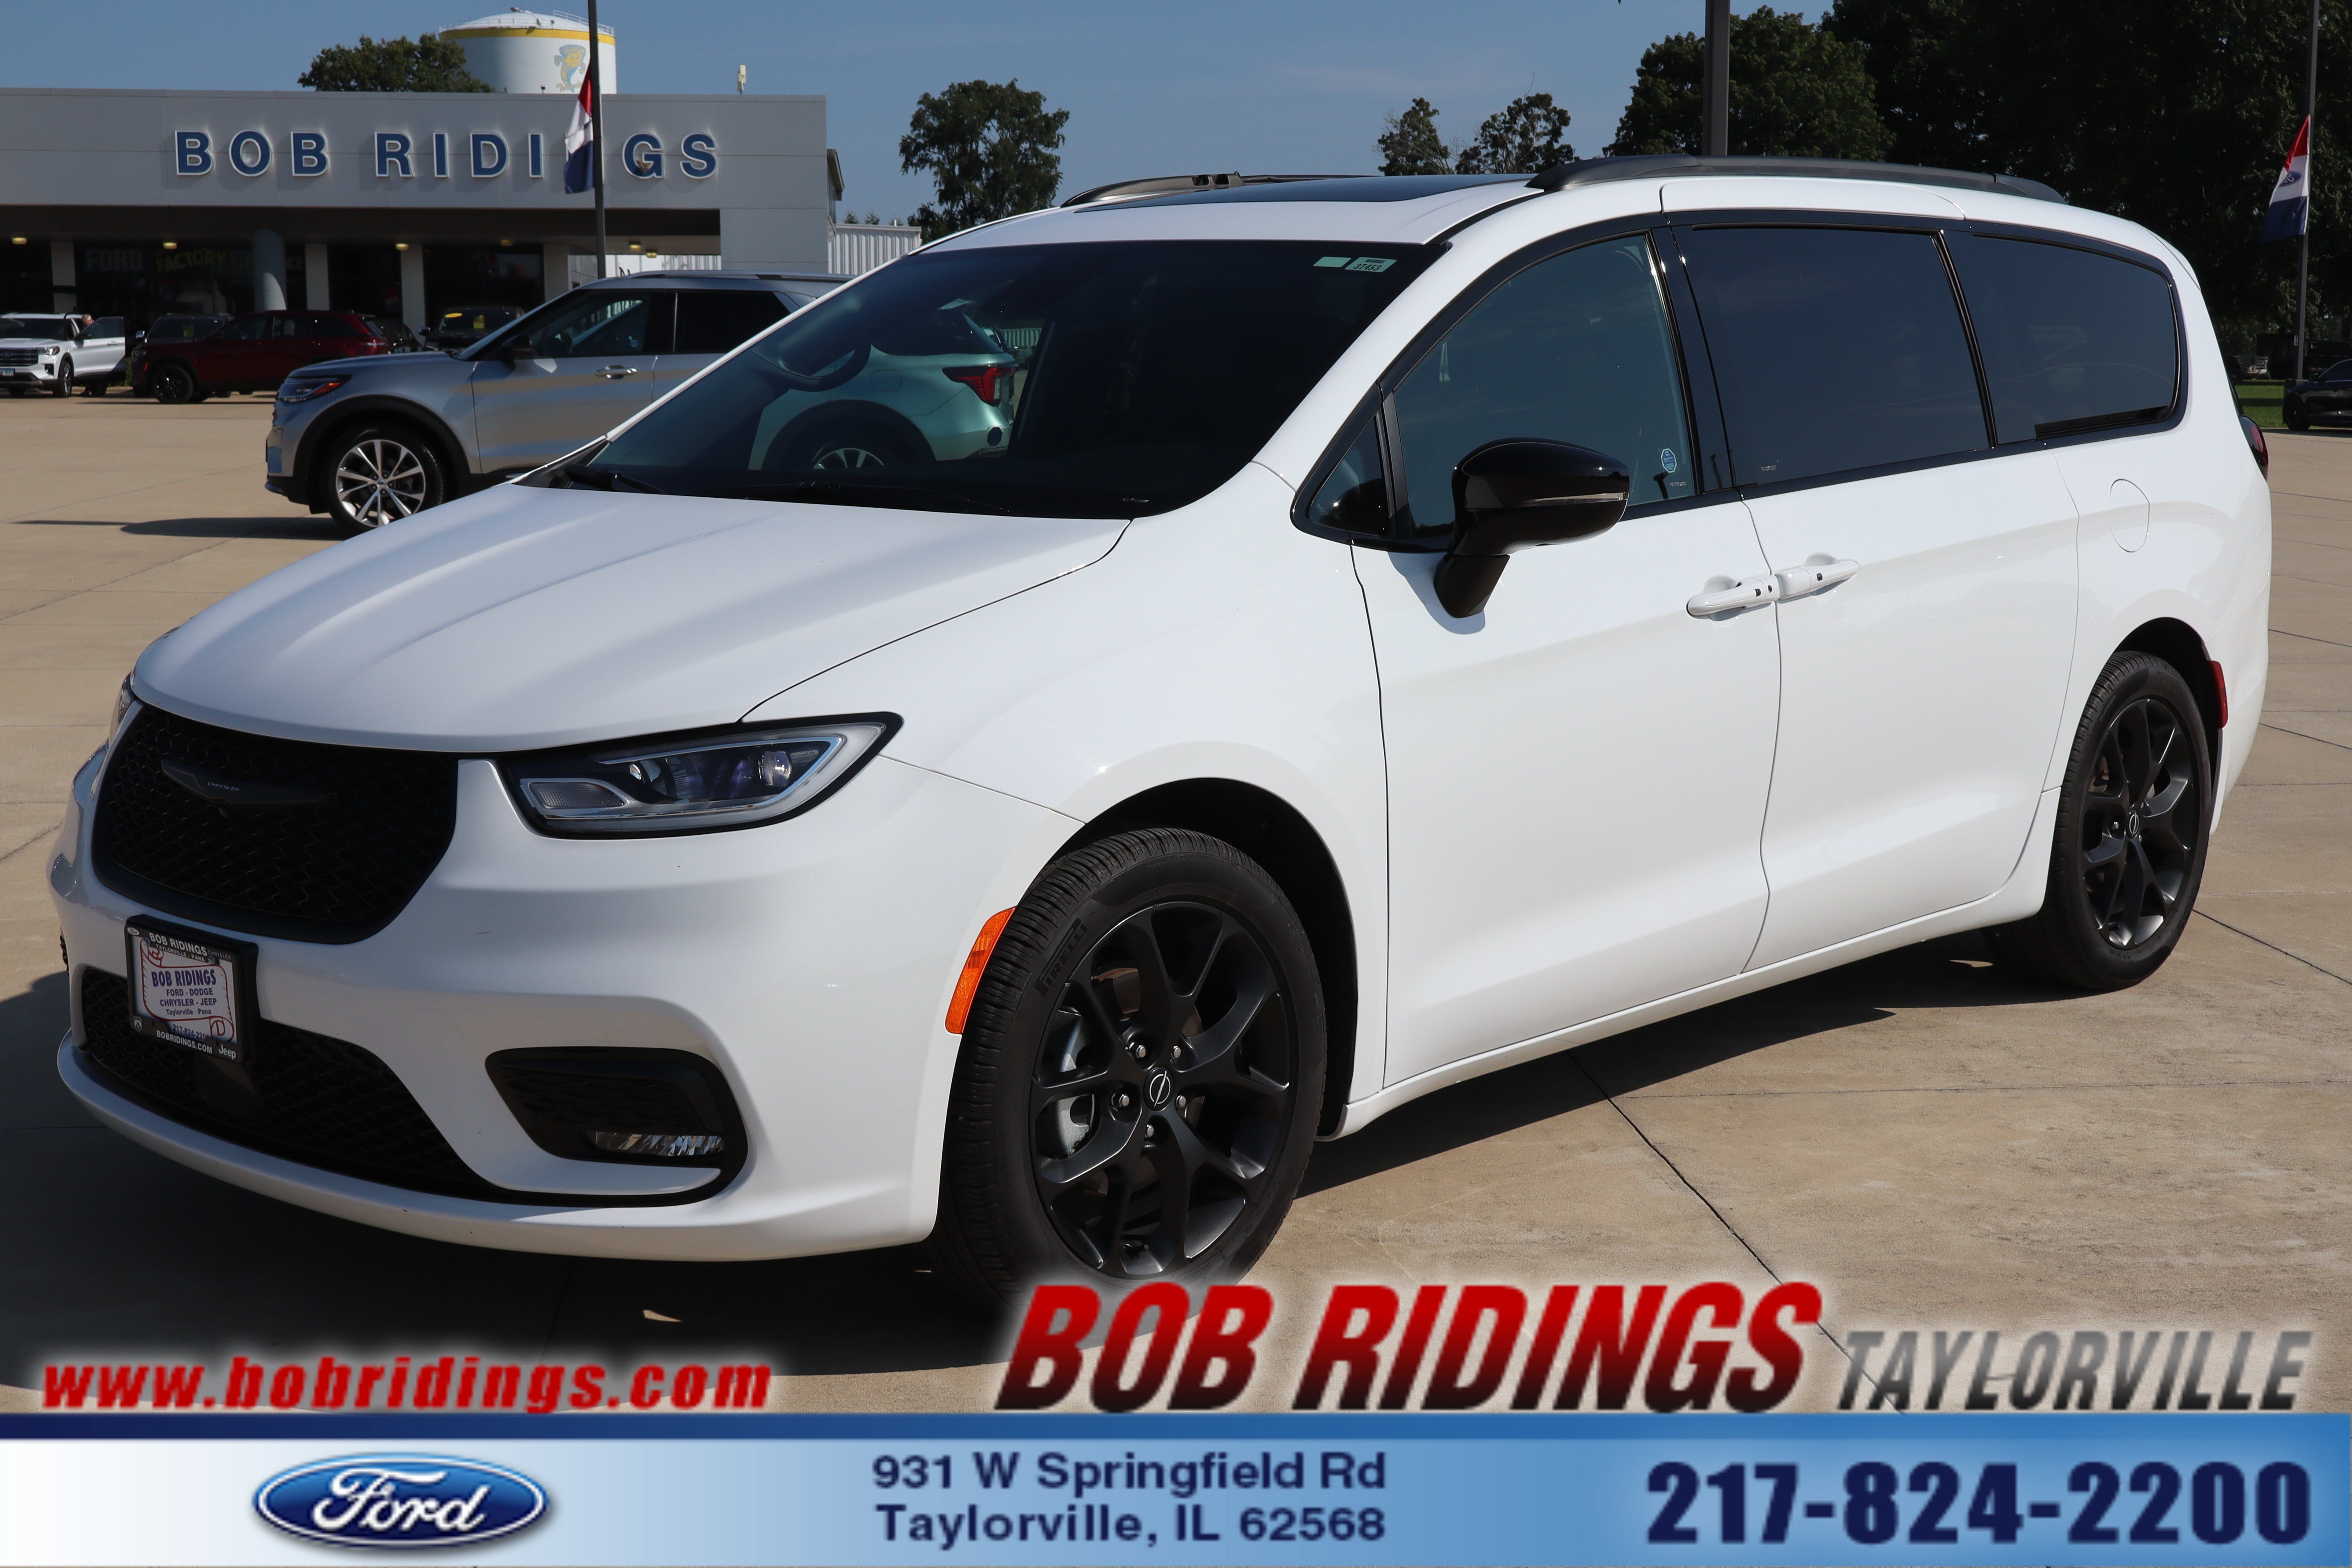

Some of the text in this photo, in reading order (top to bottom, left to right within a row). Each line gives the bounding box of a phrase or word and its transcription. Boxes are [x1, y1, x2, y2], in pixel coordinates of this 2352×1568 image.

[175, 130, 717, 179] BOB RIDIGS
[85, 248, 303, 274] FORD FACTORY CLENCE
[2099, 695, 2117, 722] OUTSIDE
[207, 782, 240, 791] CHRYSLER
[149, 932, 208, 956] BOB RIDINGS
[156, 944, 187, 957] TAYLORVILLE
[208, 950, 232, 960] CHRYSLER
[1034, 918, 1088, 997] PIRELLI
[151, 969, 216, 987] BOB RIDINGS
[166, 1008, 194, 1016] Taylorville
[156, 1030, 213, 1054] BOBRIDINGS.COM
[173, 1024, 209, 1042] 217-824-220
[218, 1045, 236, 1060] Jeep
